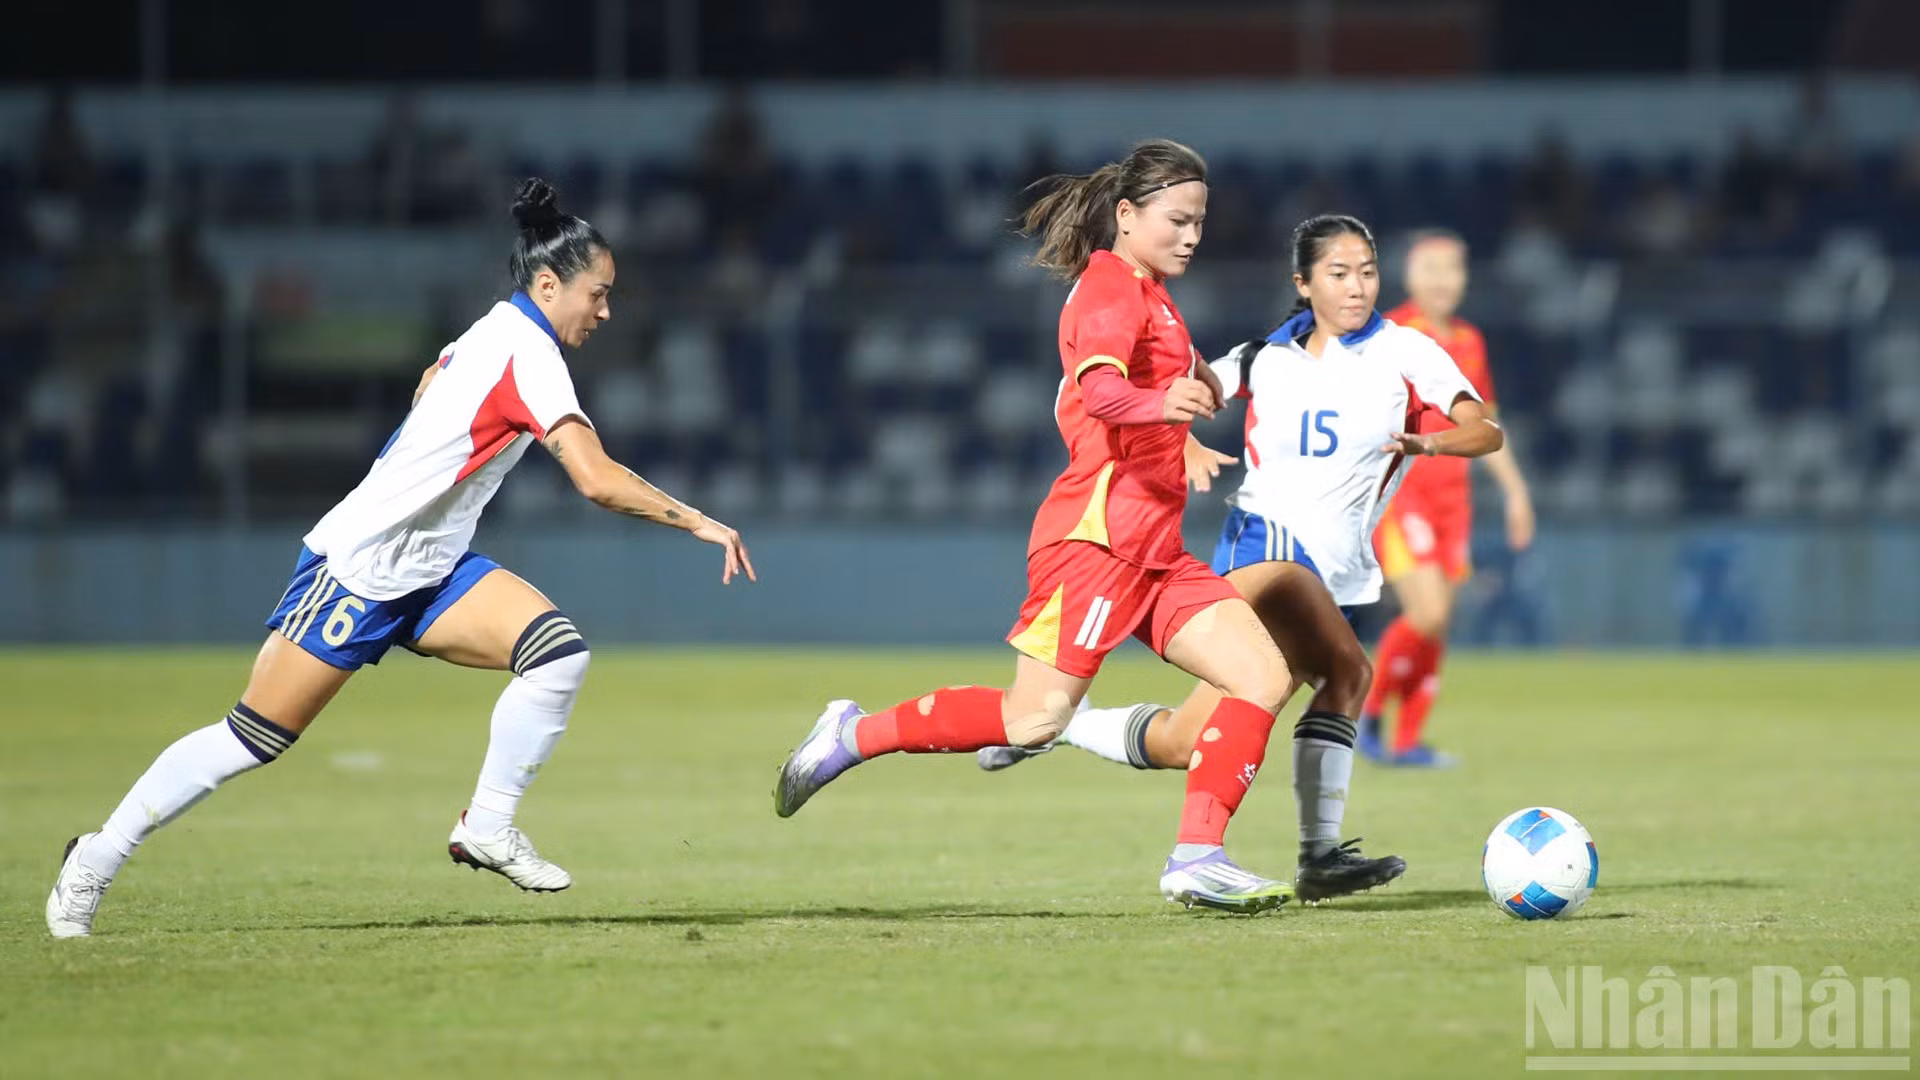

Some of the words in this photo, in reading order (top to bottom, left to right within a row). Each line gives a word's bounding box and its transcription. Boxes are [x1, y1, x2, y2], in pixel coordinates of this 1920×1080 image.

[1300, 409, 1339, 457] 15
[322, 595, 366, 646] 6
[1073, 596, 1113, 650] 11
